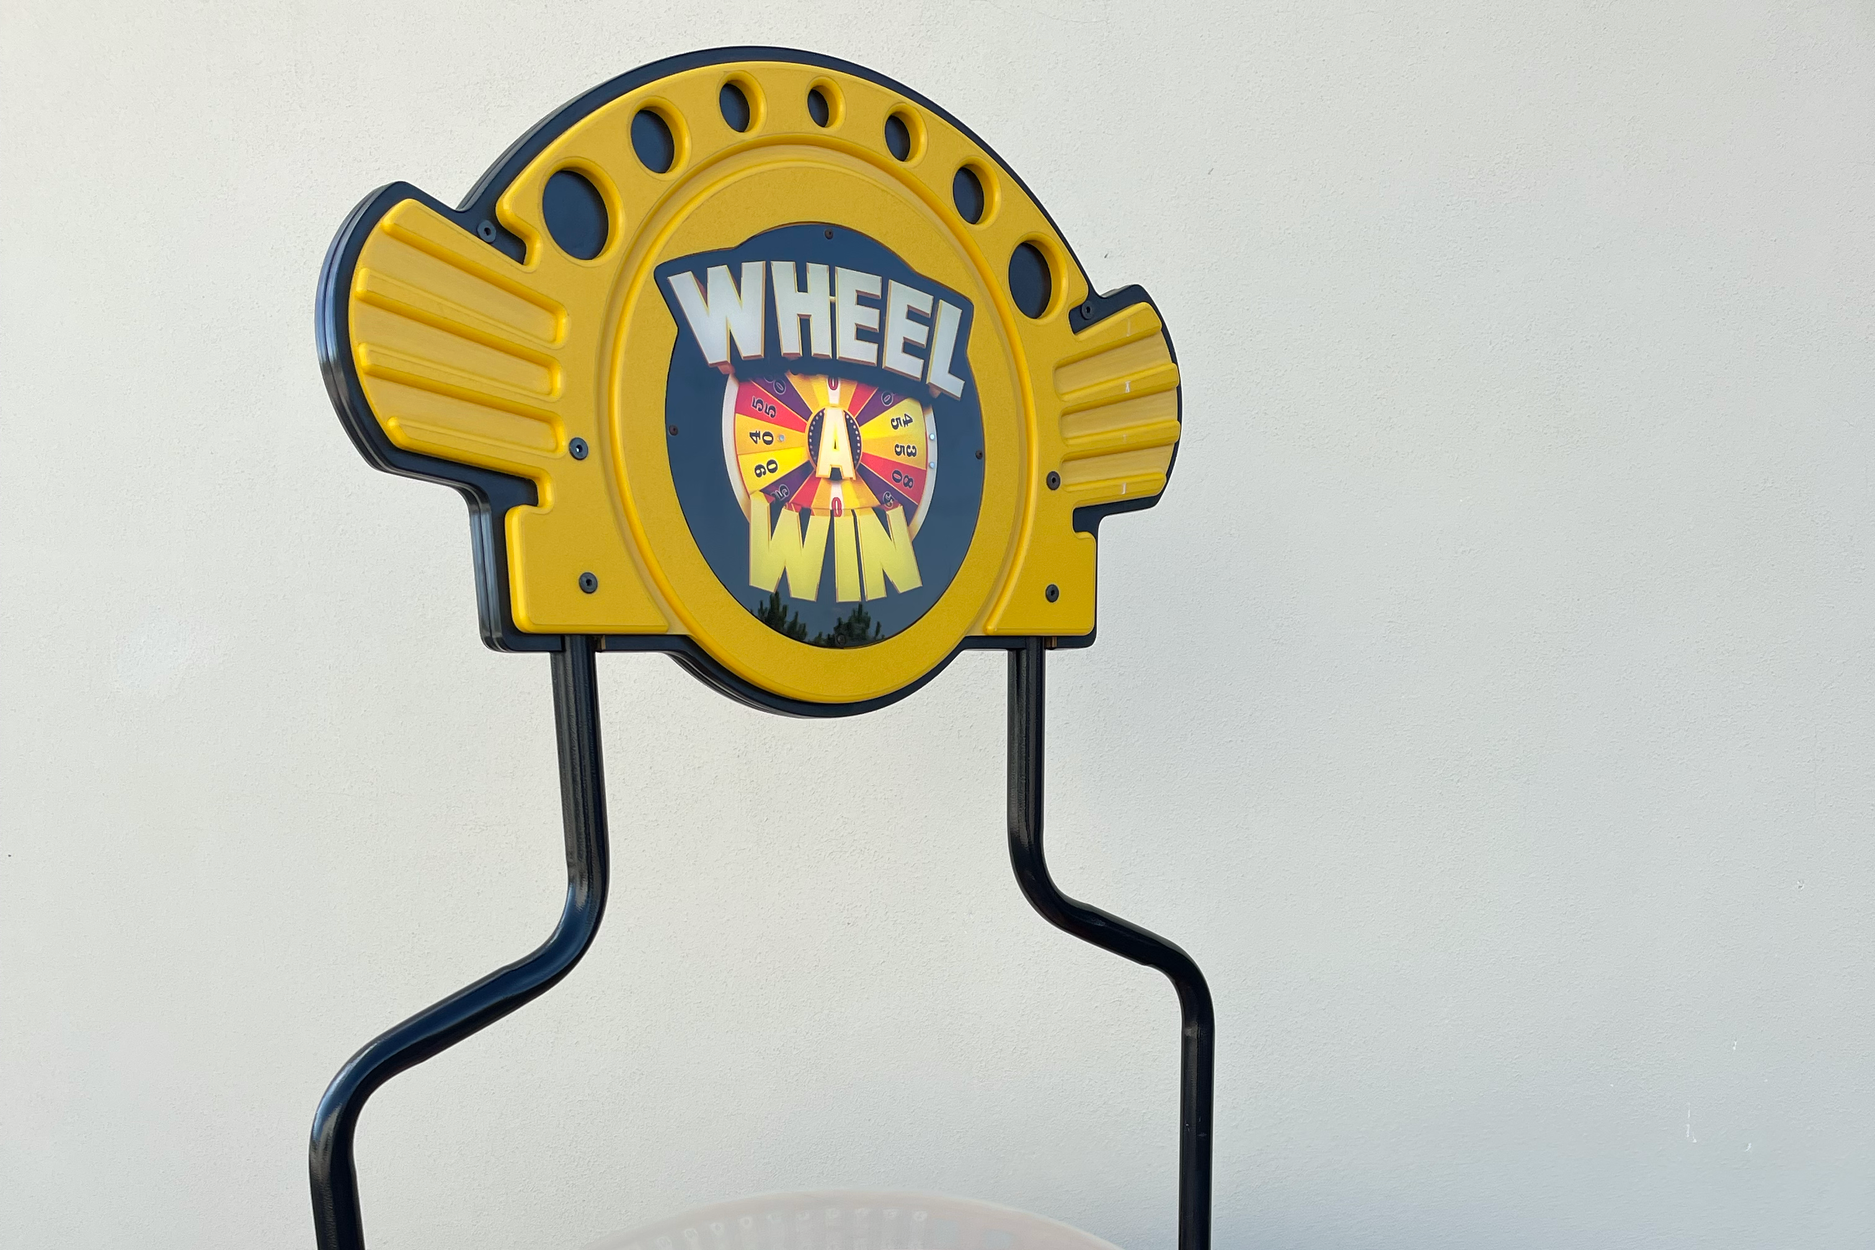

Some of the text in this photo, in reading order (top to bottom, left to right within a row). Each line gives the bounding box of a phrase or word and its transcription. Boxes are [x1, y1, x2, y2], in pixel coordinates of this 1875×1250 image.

[667, 260, 966, 400] WHEEL
[751, 396, 777, 419] 55
[890, 413, 914, 431] 45
[749, 430, 774, 446] 40
[815, 407, 857, 481] A
[894, 443, 917, 458] 35
[754, 459, 779, 479] 90
[891, 469, 915, 490] 80
[749, 490, 923, 602] WIN
